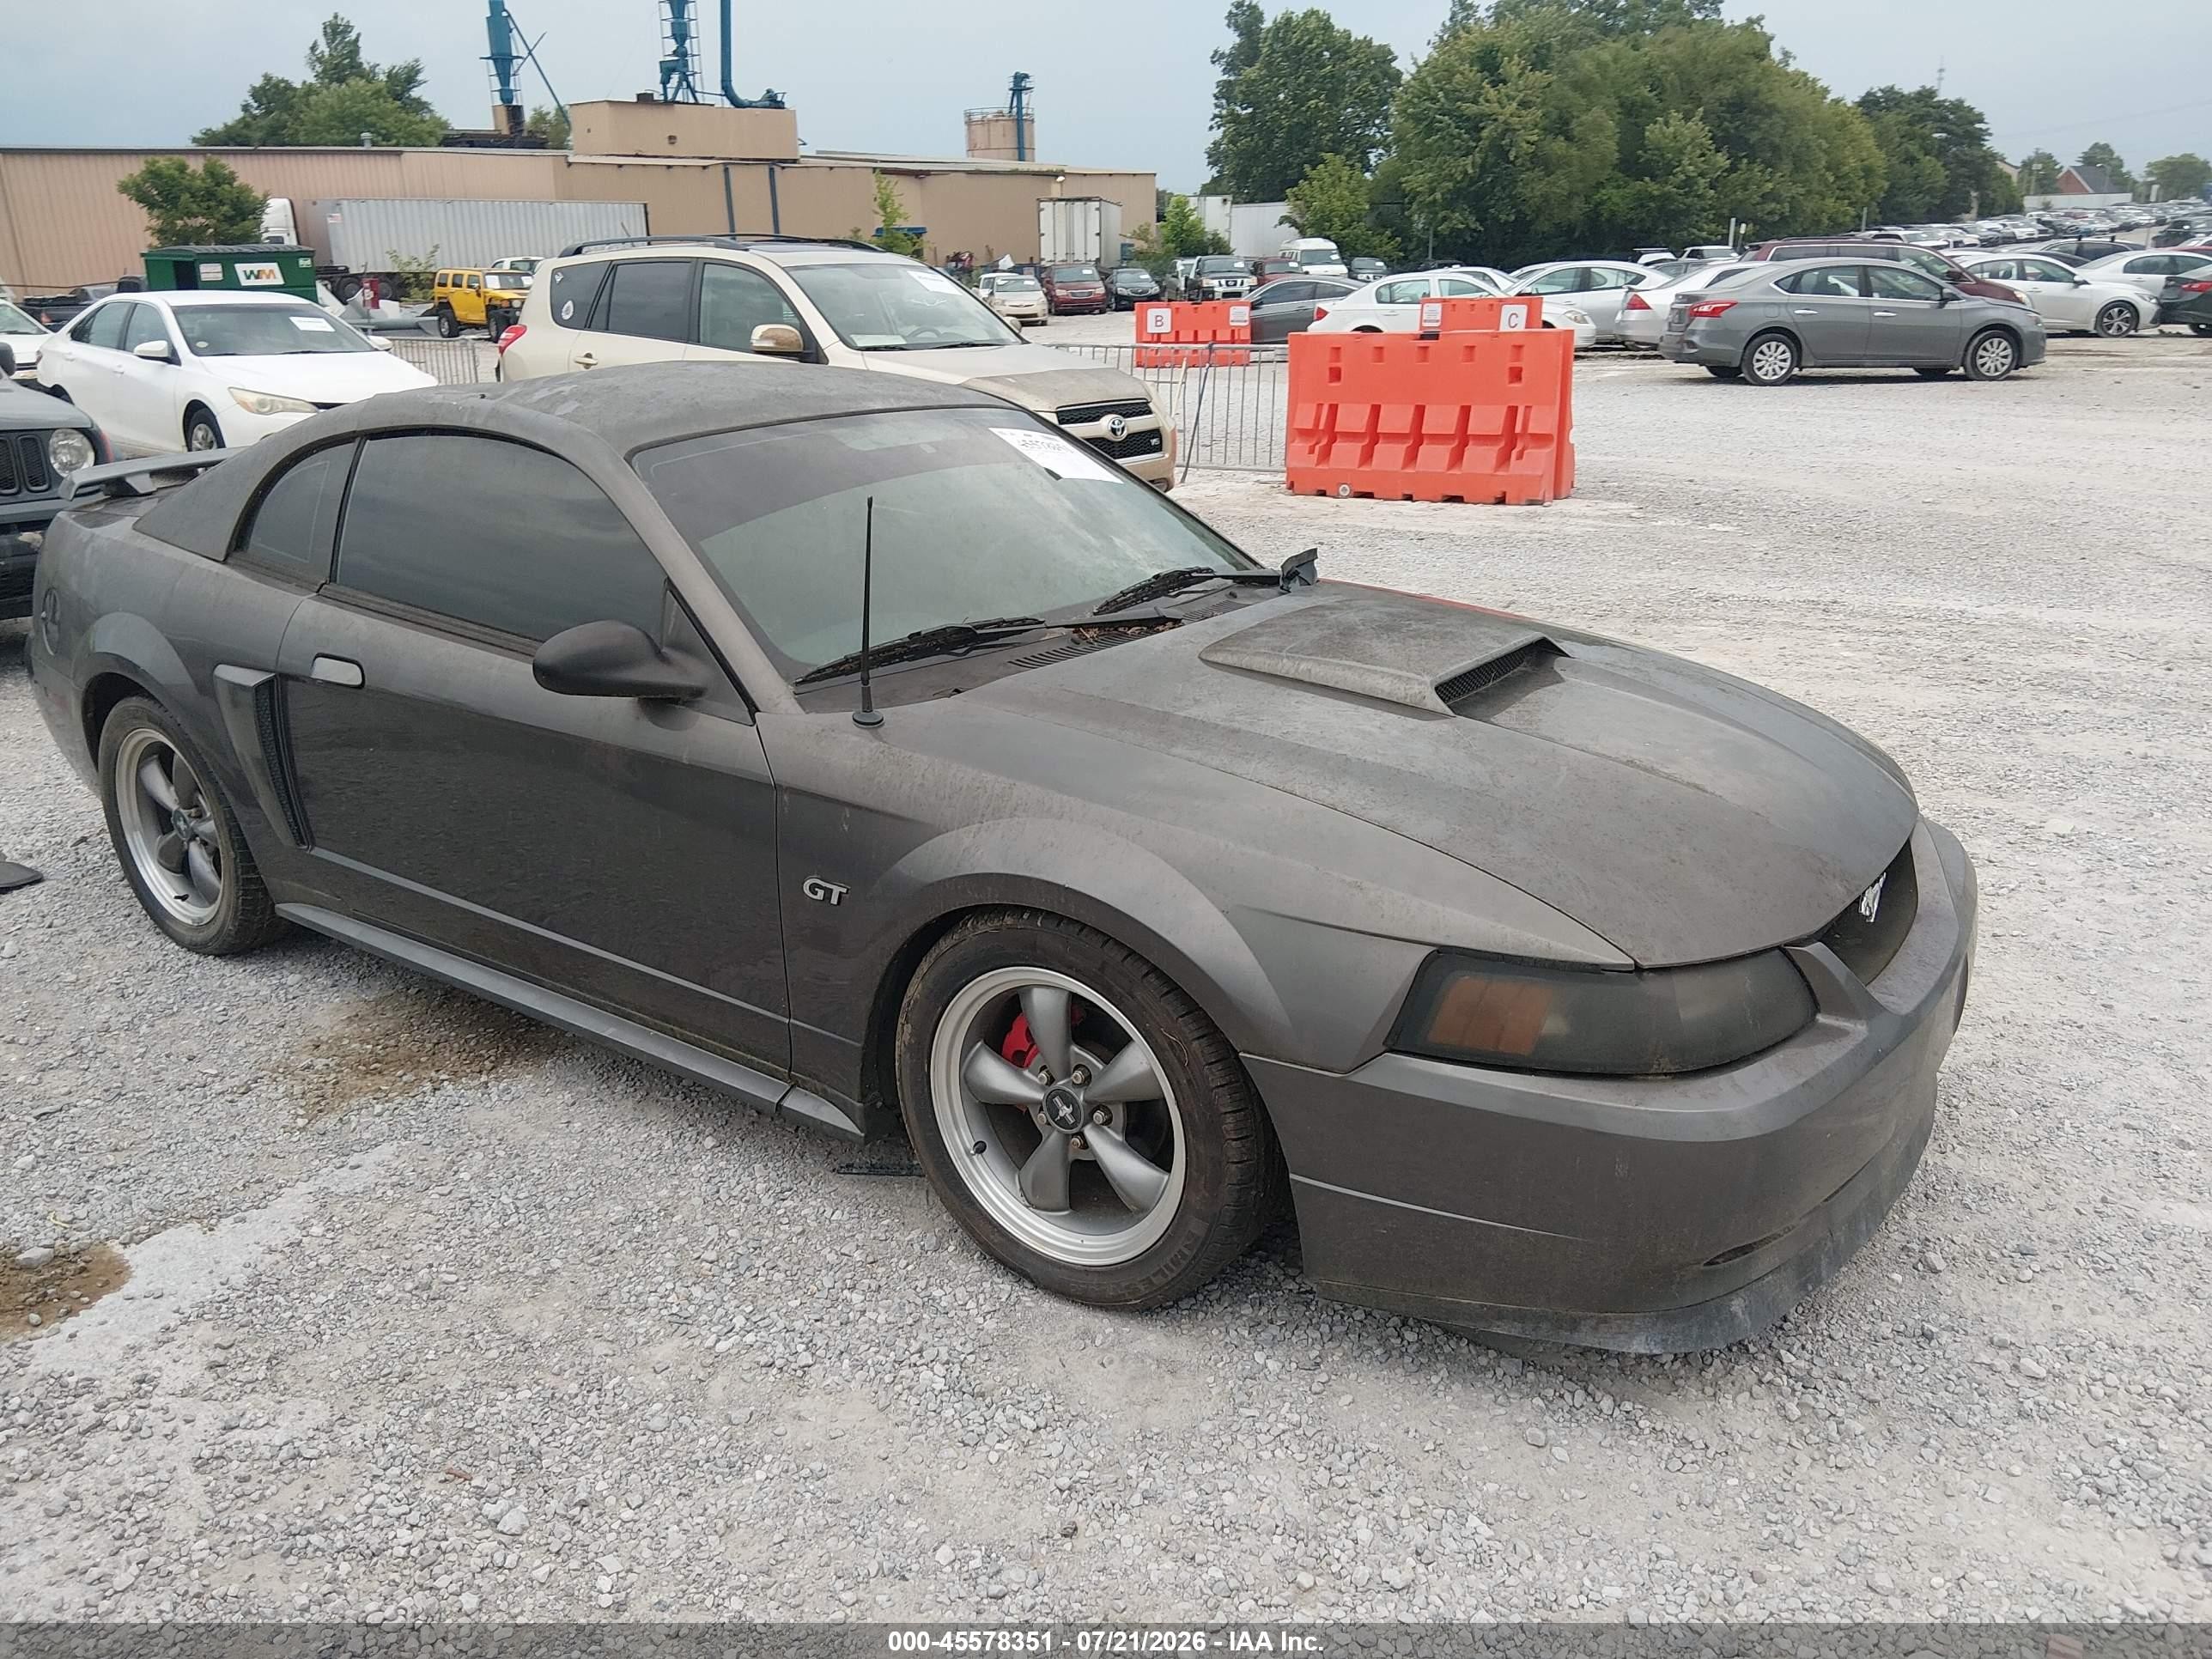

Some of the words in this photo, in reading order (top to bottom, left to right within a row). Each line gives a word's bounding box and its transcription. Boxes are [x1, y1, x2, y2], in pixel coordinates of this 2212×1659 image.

[243, 270, 276, 280] WM
[1155, 315, 1164, 327] B
[1508, 313, 1519, 328] C
[803, 878, 848, 905] GT
